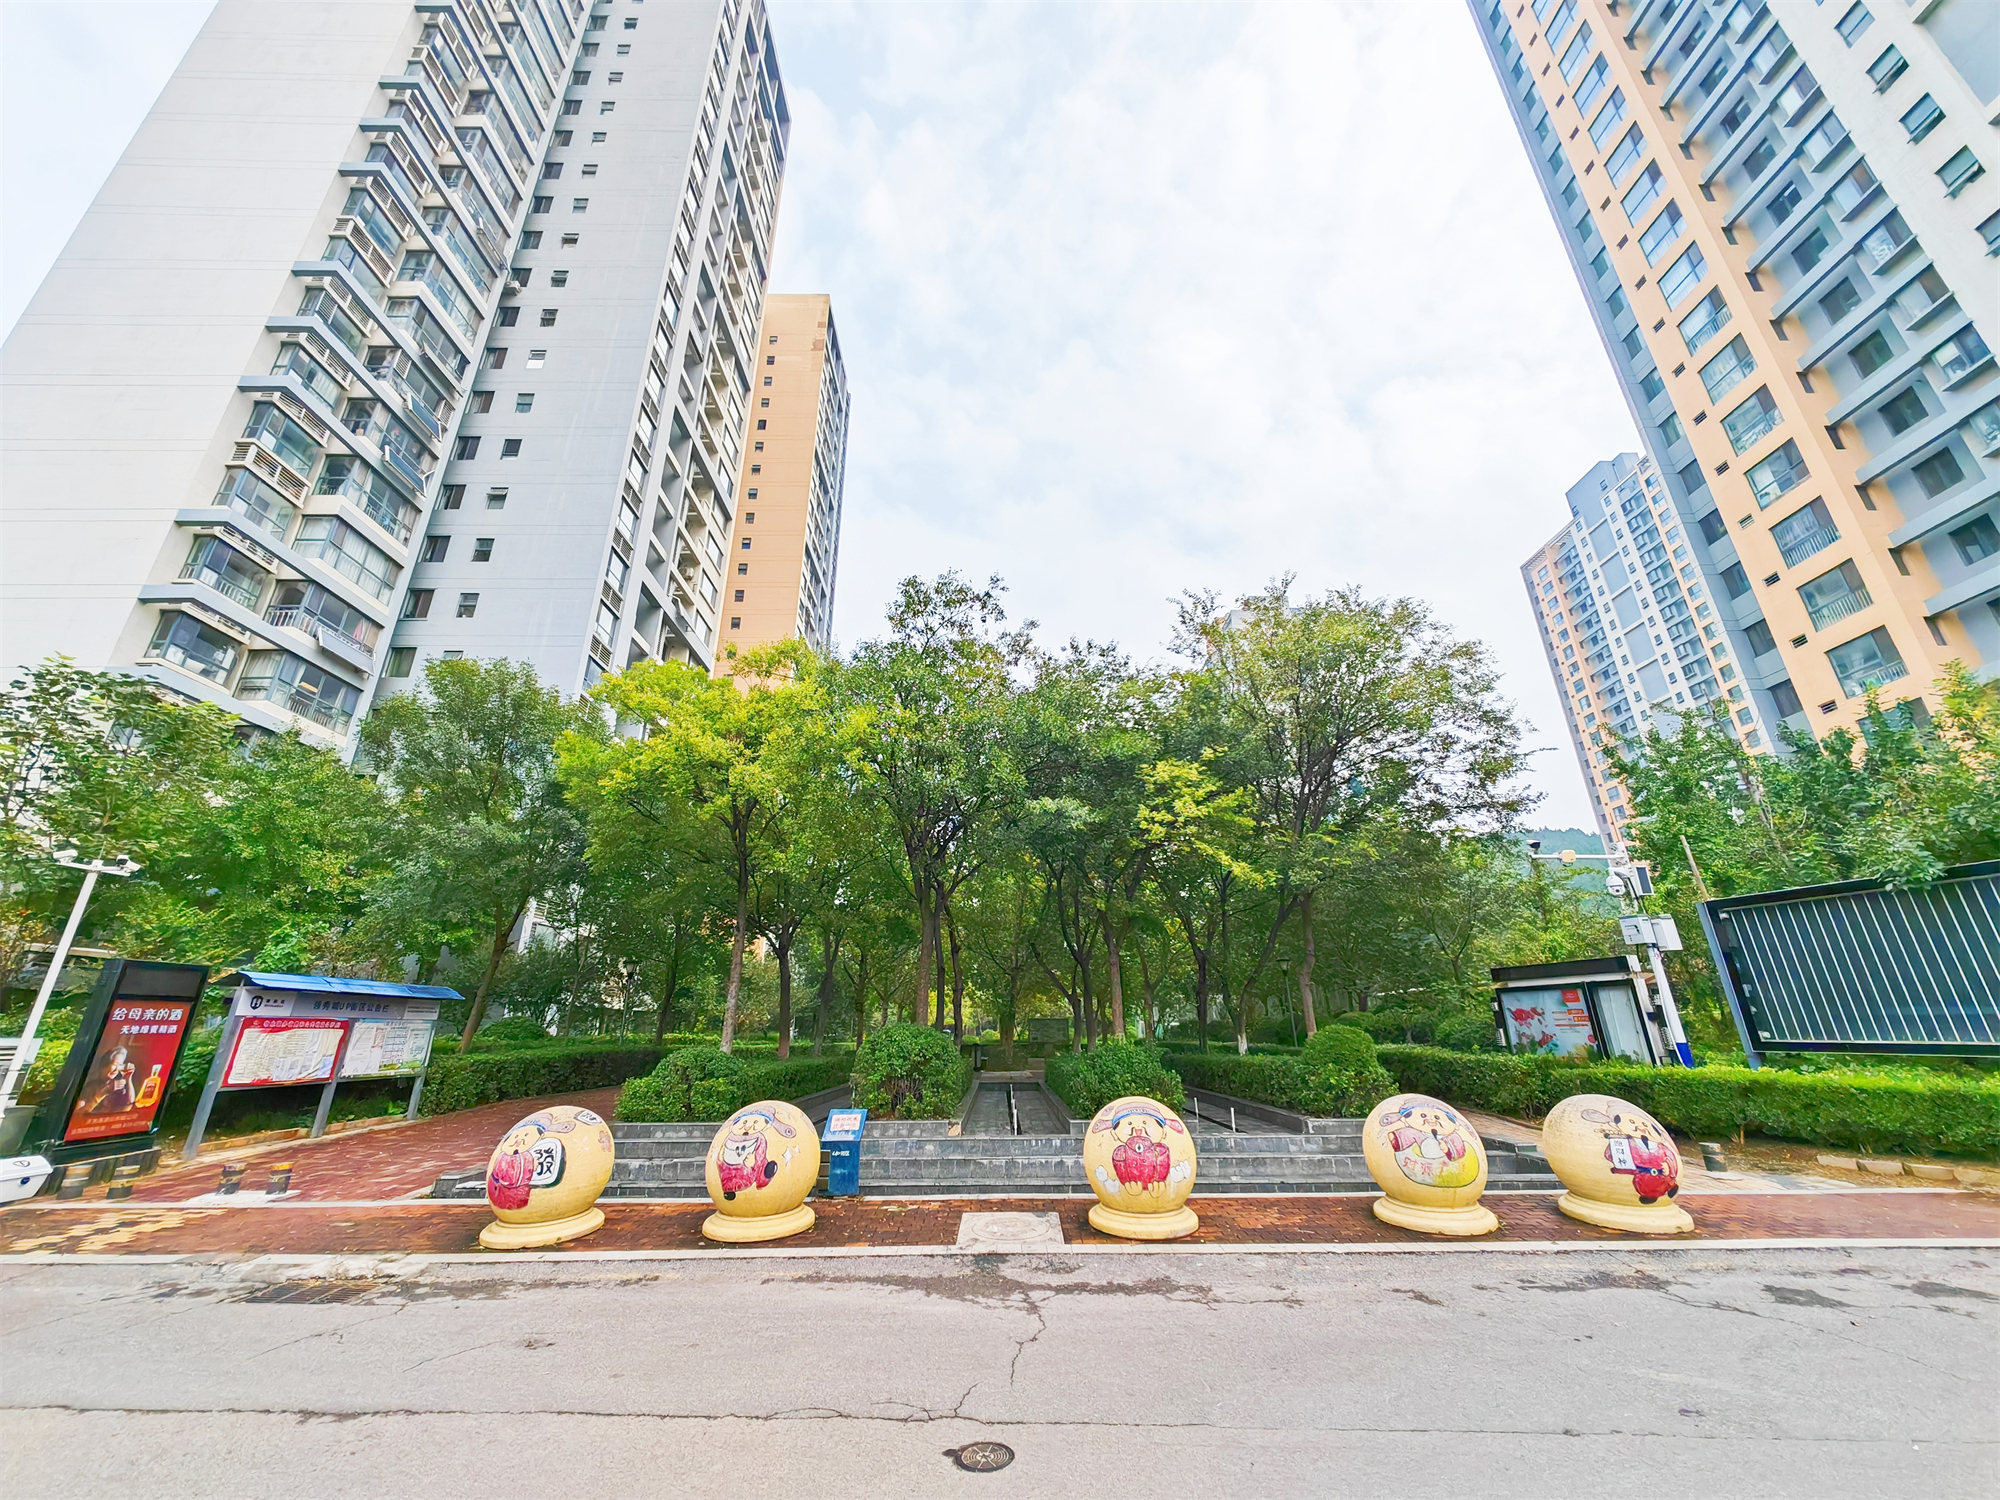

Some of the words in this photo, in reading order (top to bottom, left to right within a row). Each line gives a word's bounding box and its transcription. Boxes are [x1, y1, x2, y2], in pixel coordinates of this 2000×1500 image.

[112, 1008, 183, 1020] 给母亲的酒
